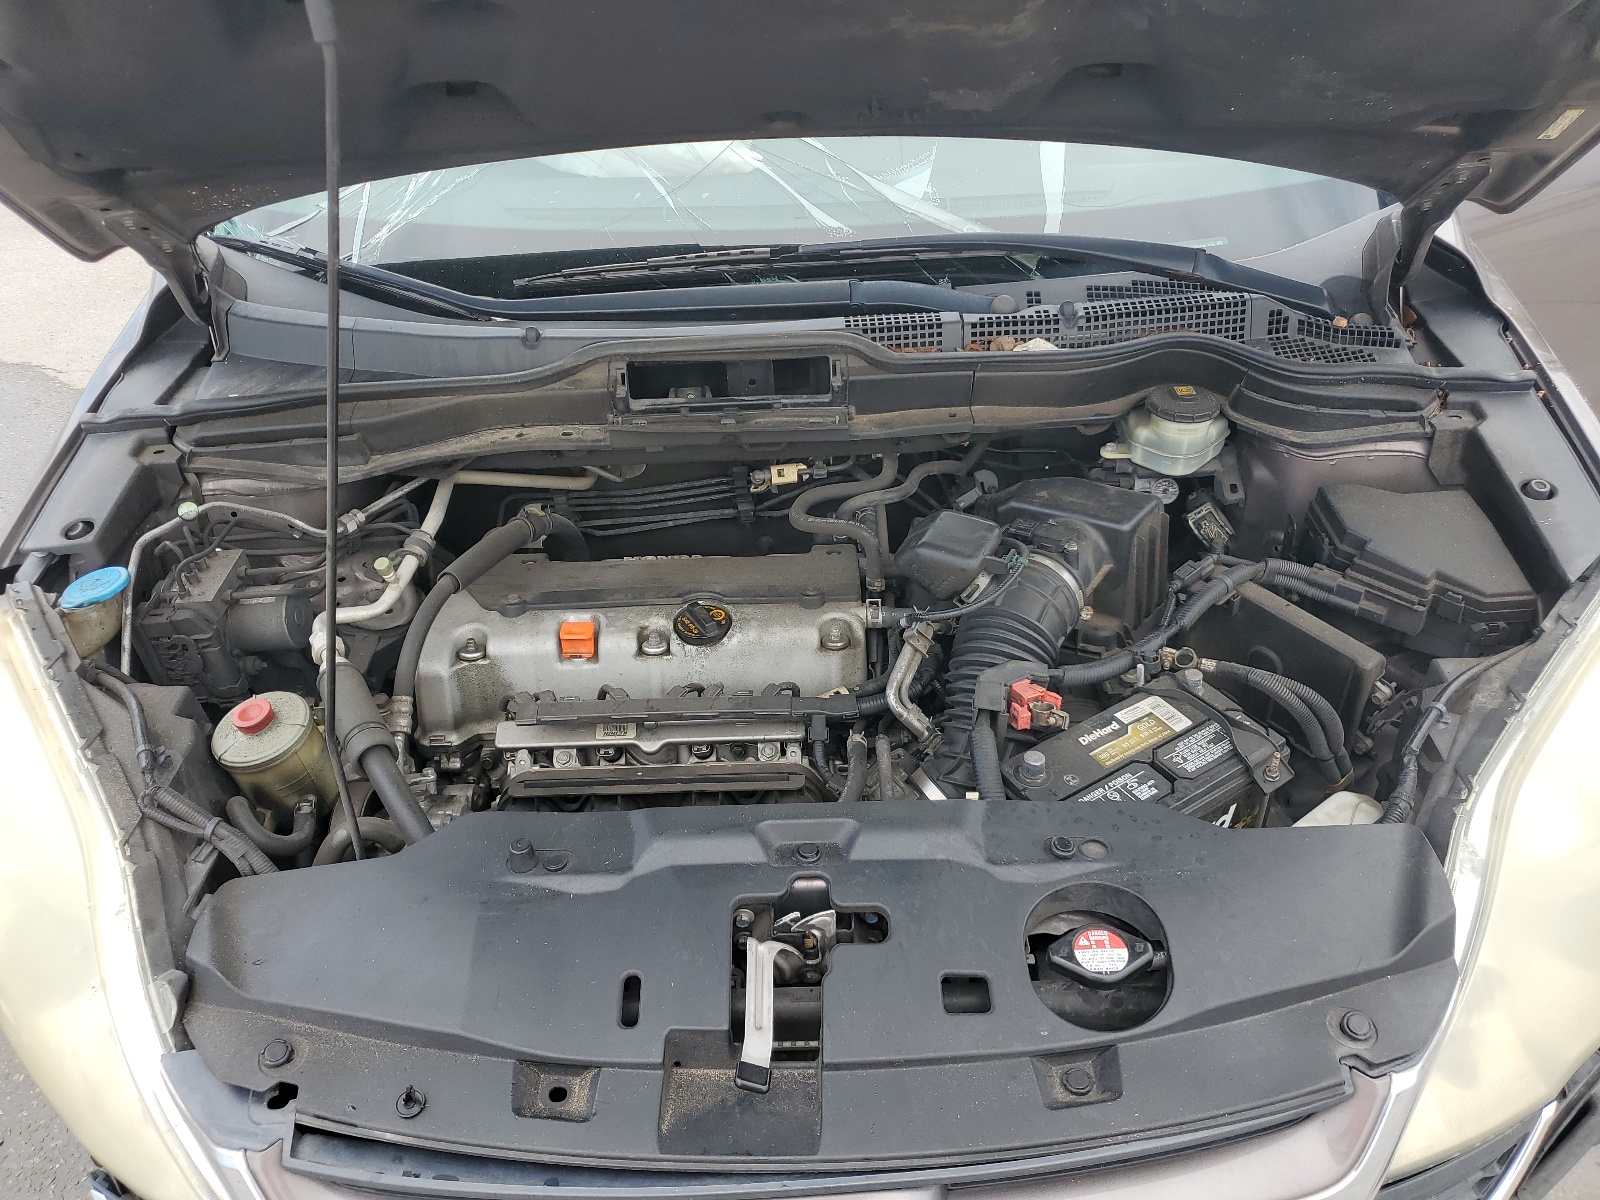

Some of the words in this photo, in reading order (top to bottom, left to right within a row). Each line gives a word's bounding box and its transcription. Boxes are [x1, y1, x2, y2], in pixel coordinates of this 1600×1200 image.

[1137, 719, 1156, 731] GOLD
[1078, 721, 1120, 746] DieHard
[1107, 772, 1133, 788] POISON
